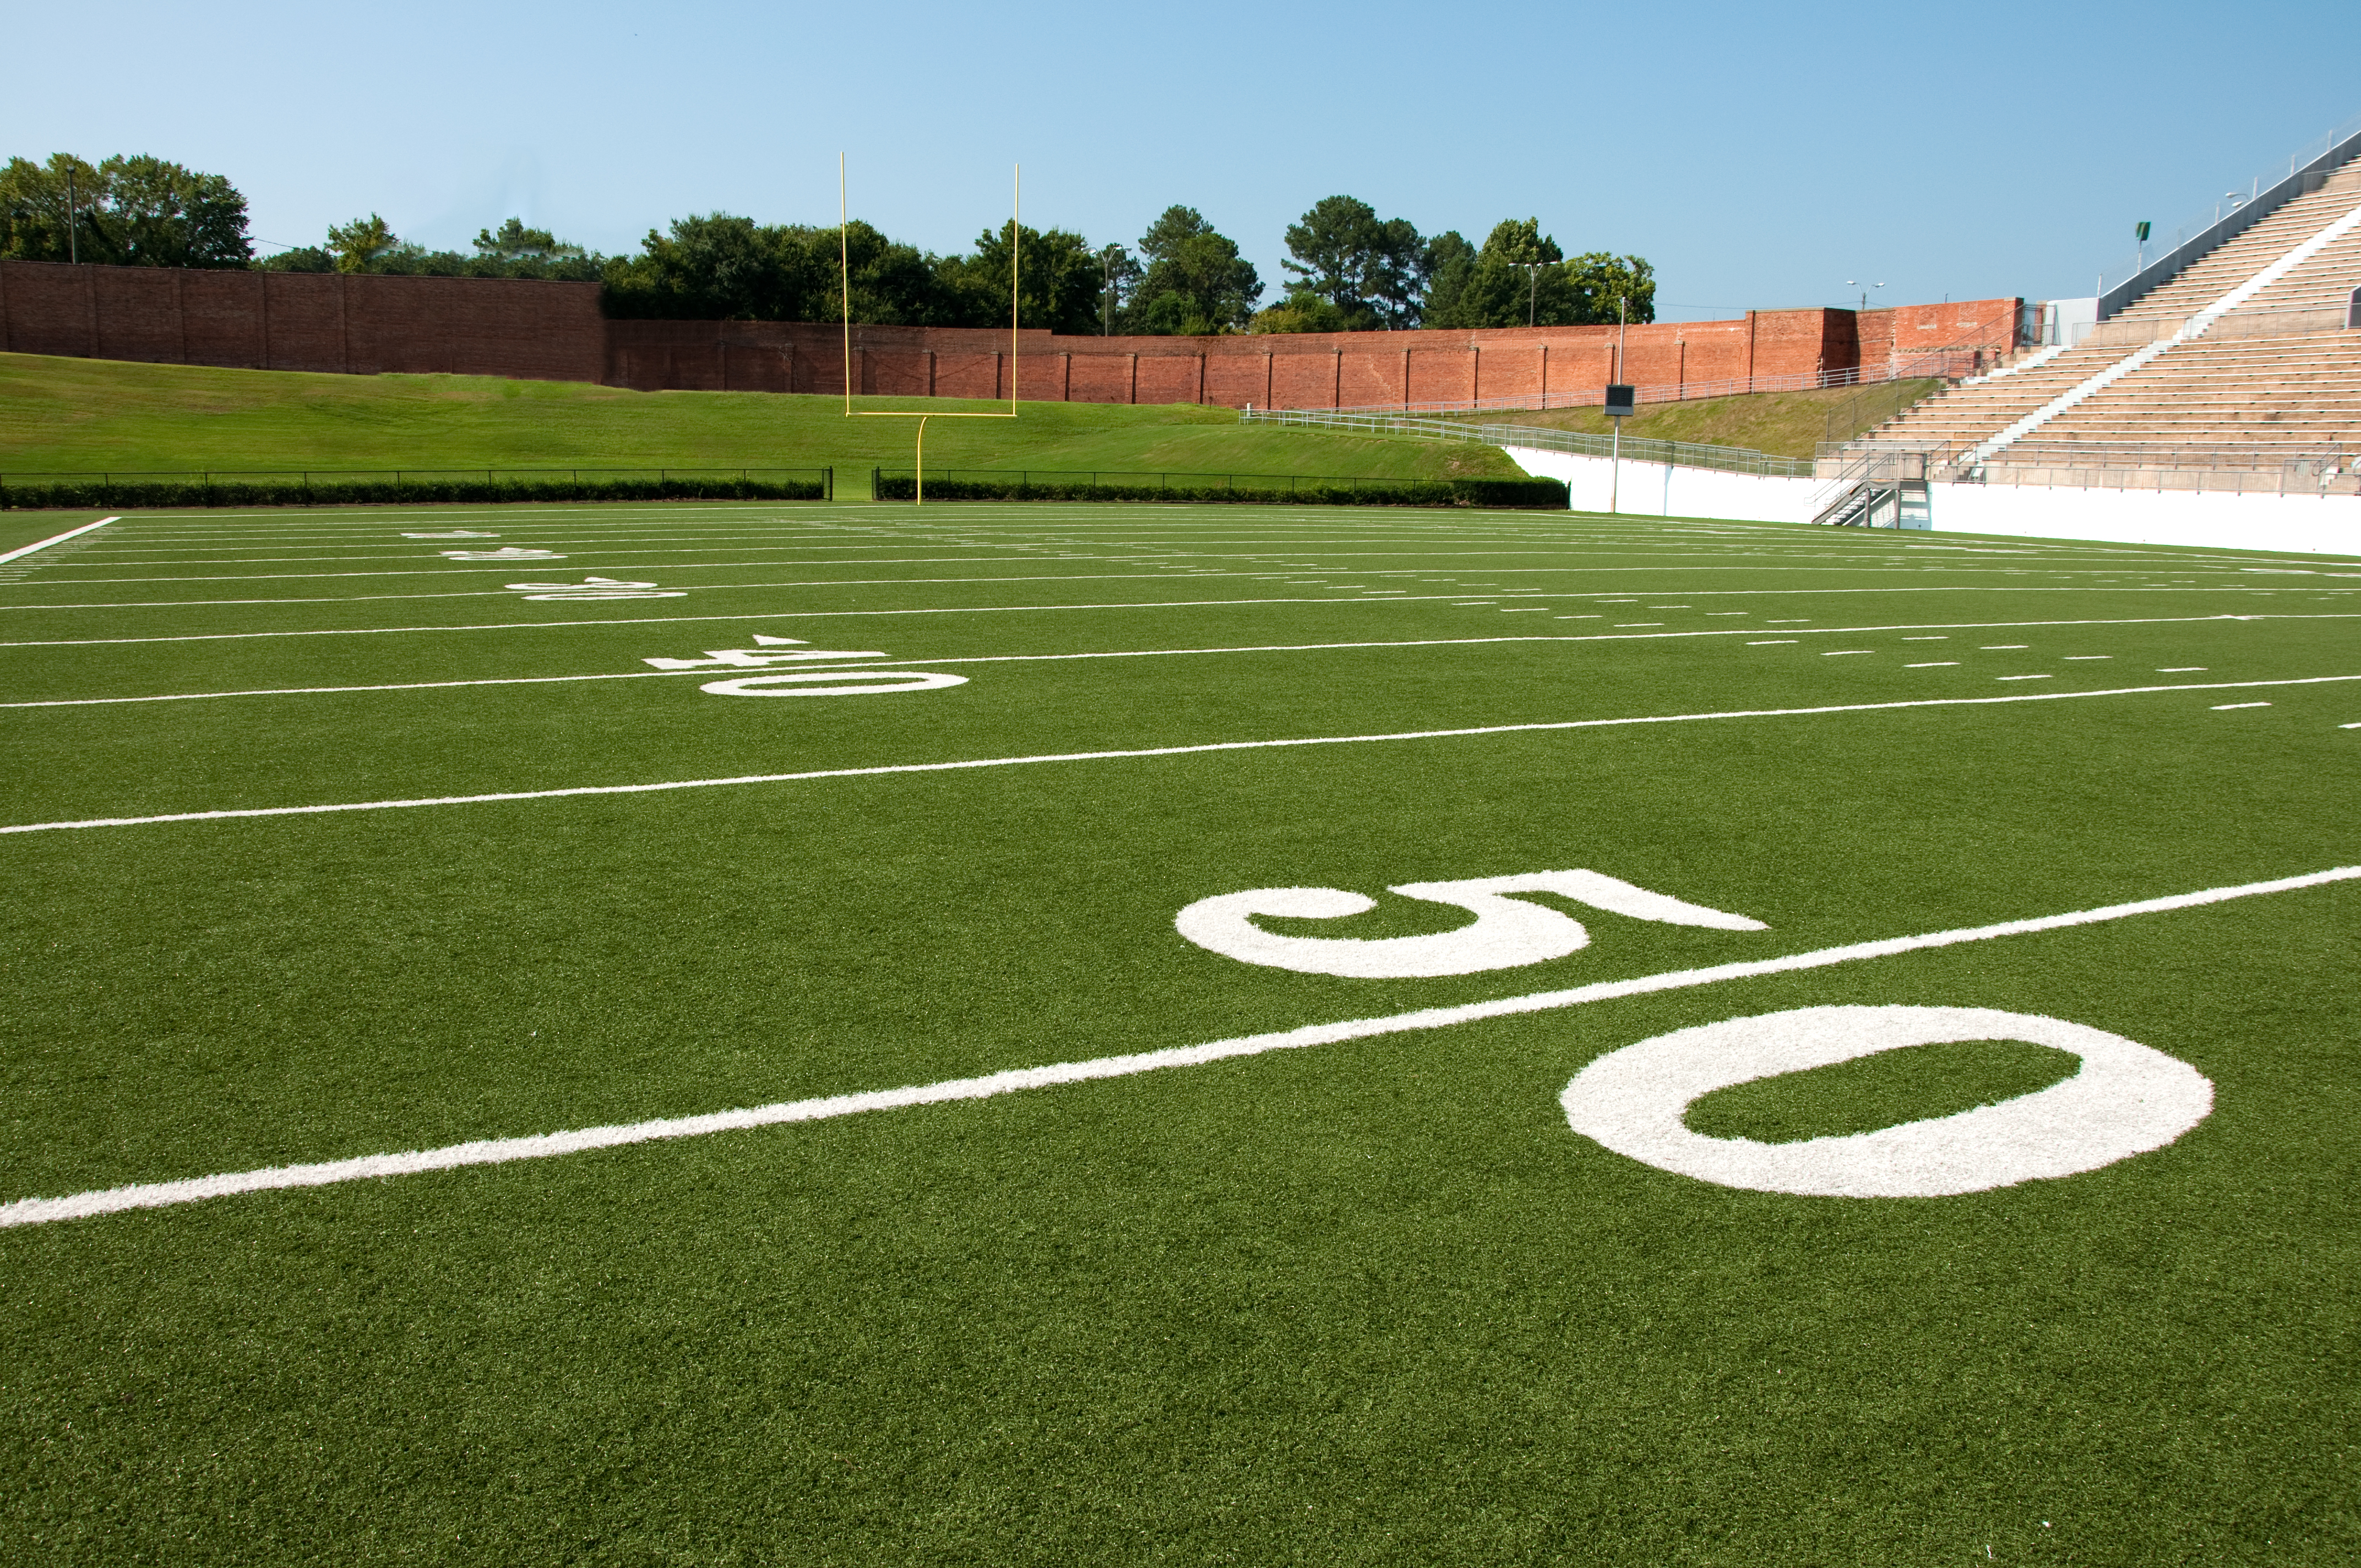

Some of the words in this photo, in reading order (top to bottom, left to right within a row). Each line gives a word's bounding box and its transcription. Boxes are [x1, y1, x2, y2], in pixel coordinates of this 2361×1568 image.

[504, 581, 688, 601] 30
[641, 649, 970, 697] 40
[1171, 868, 2216, 1199] 50
